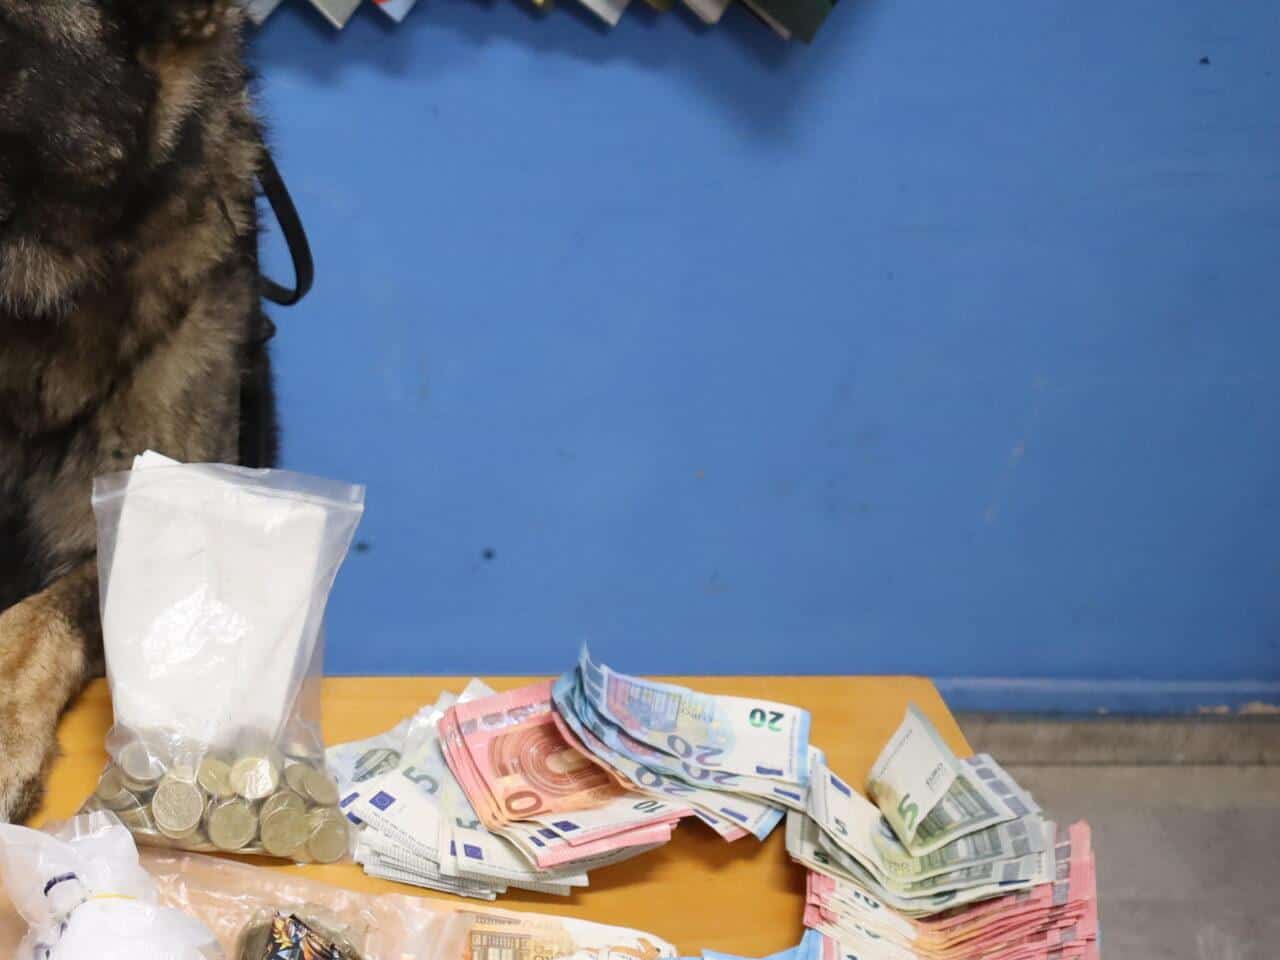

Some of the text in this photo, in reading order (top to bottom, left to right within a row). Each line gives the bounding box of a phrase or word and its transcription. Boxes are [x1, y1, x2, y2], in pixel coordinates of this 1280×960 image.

[749, 707, 784, 732] 20
[667, 734, 724, 767] 20
[402, 766, 439, 795] 5
